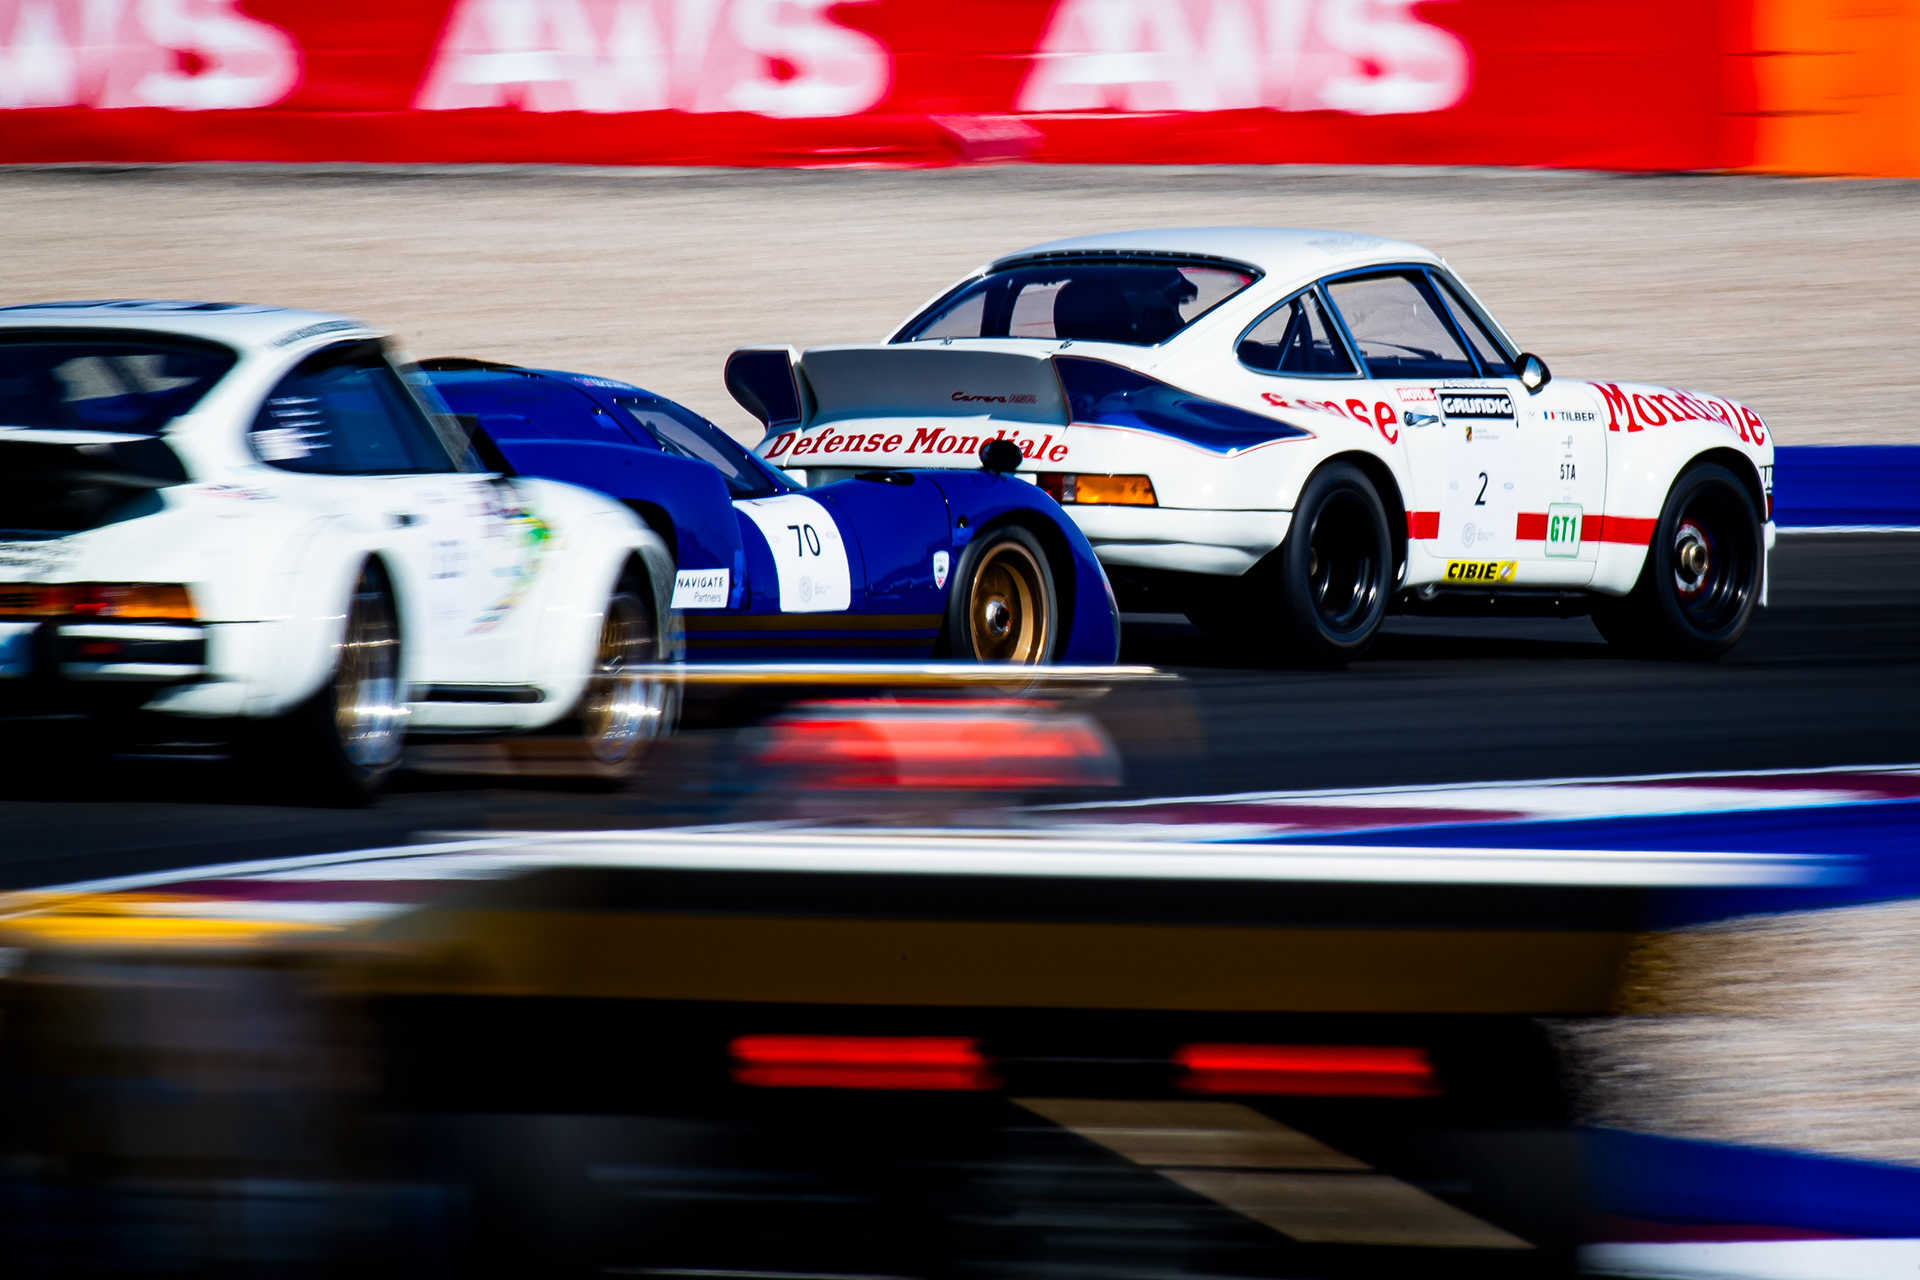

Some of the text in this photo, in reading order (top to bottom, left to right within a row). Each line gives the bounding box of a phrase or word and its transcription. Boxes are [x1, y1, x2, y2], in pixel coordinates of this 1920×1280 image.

[951, 391, 1007, 403] Carrera
[1442, 397, 1513, 414] GRUNDIG
[764, 428, 903, 460] Defense
[1474, 472, 1488, 506] 2
[1550, 515, 1577, 542] GT1
[787, 524, 821, 557] 70
[1447, 562, 1498, 580] CIBIE
[677, 576, 723, 589] NAVIGATE
[693, 591, 722, 603] Partners
